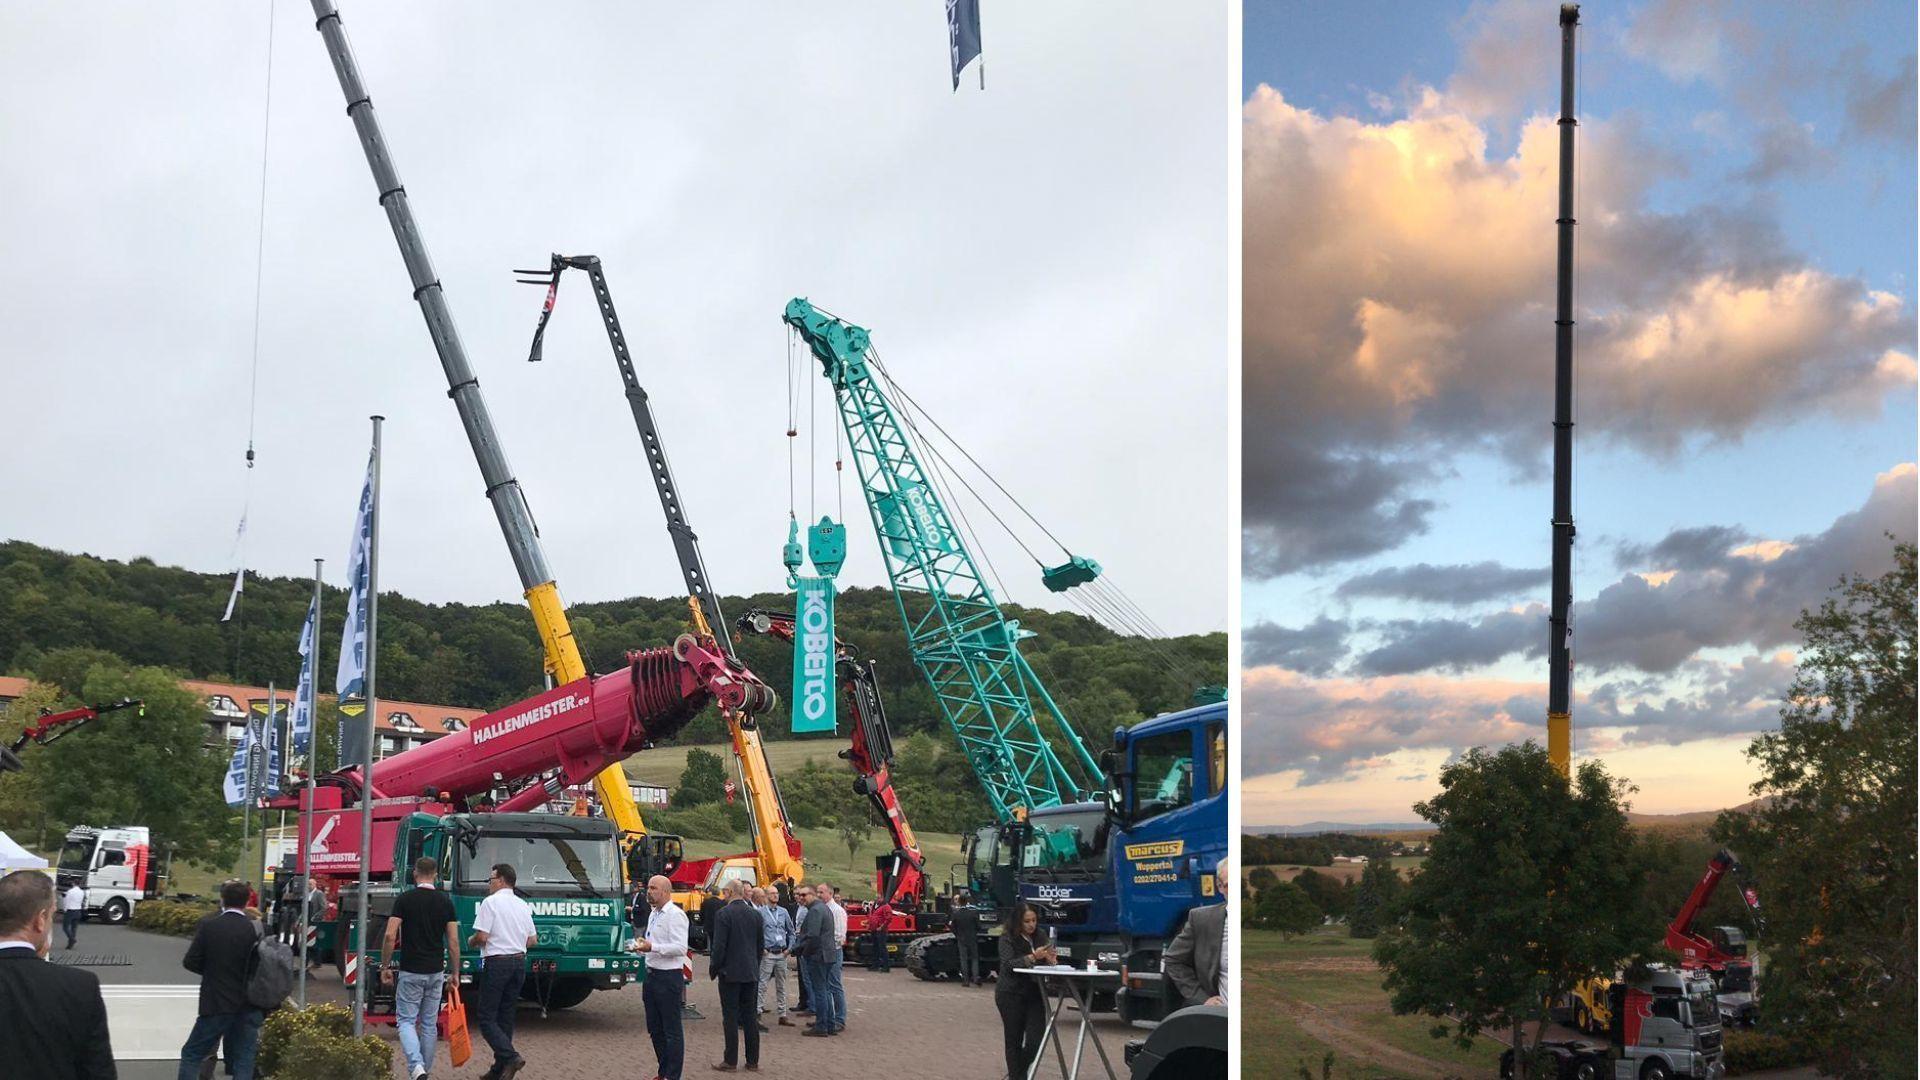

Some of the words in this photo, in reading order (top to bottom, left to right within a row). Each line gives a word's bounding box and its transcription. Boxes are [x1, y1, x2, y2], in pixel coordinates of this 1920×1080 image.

[906, 486, 941, 544] KOBELCO
[803, 590, 828, 720] KOBELCO
[1130, 843, 1178, 856] marcus
[1135, 861, 1173, 872] Wuppertal
[1039, 886, 1073, 898] Böcker
